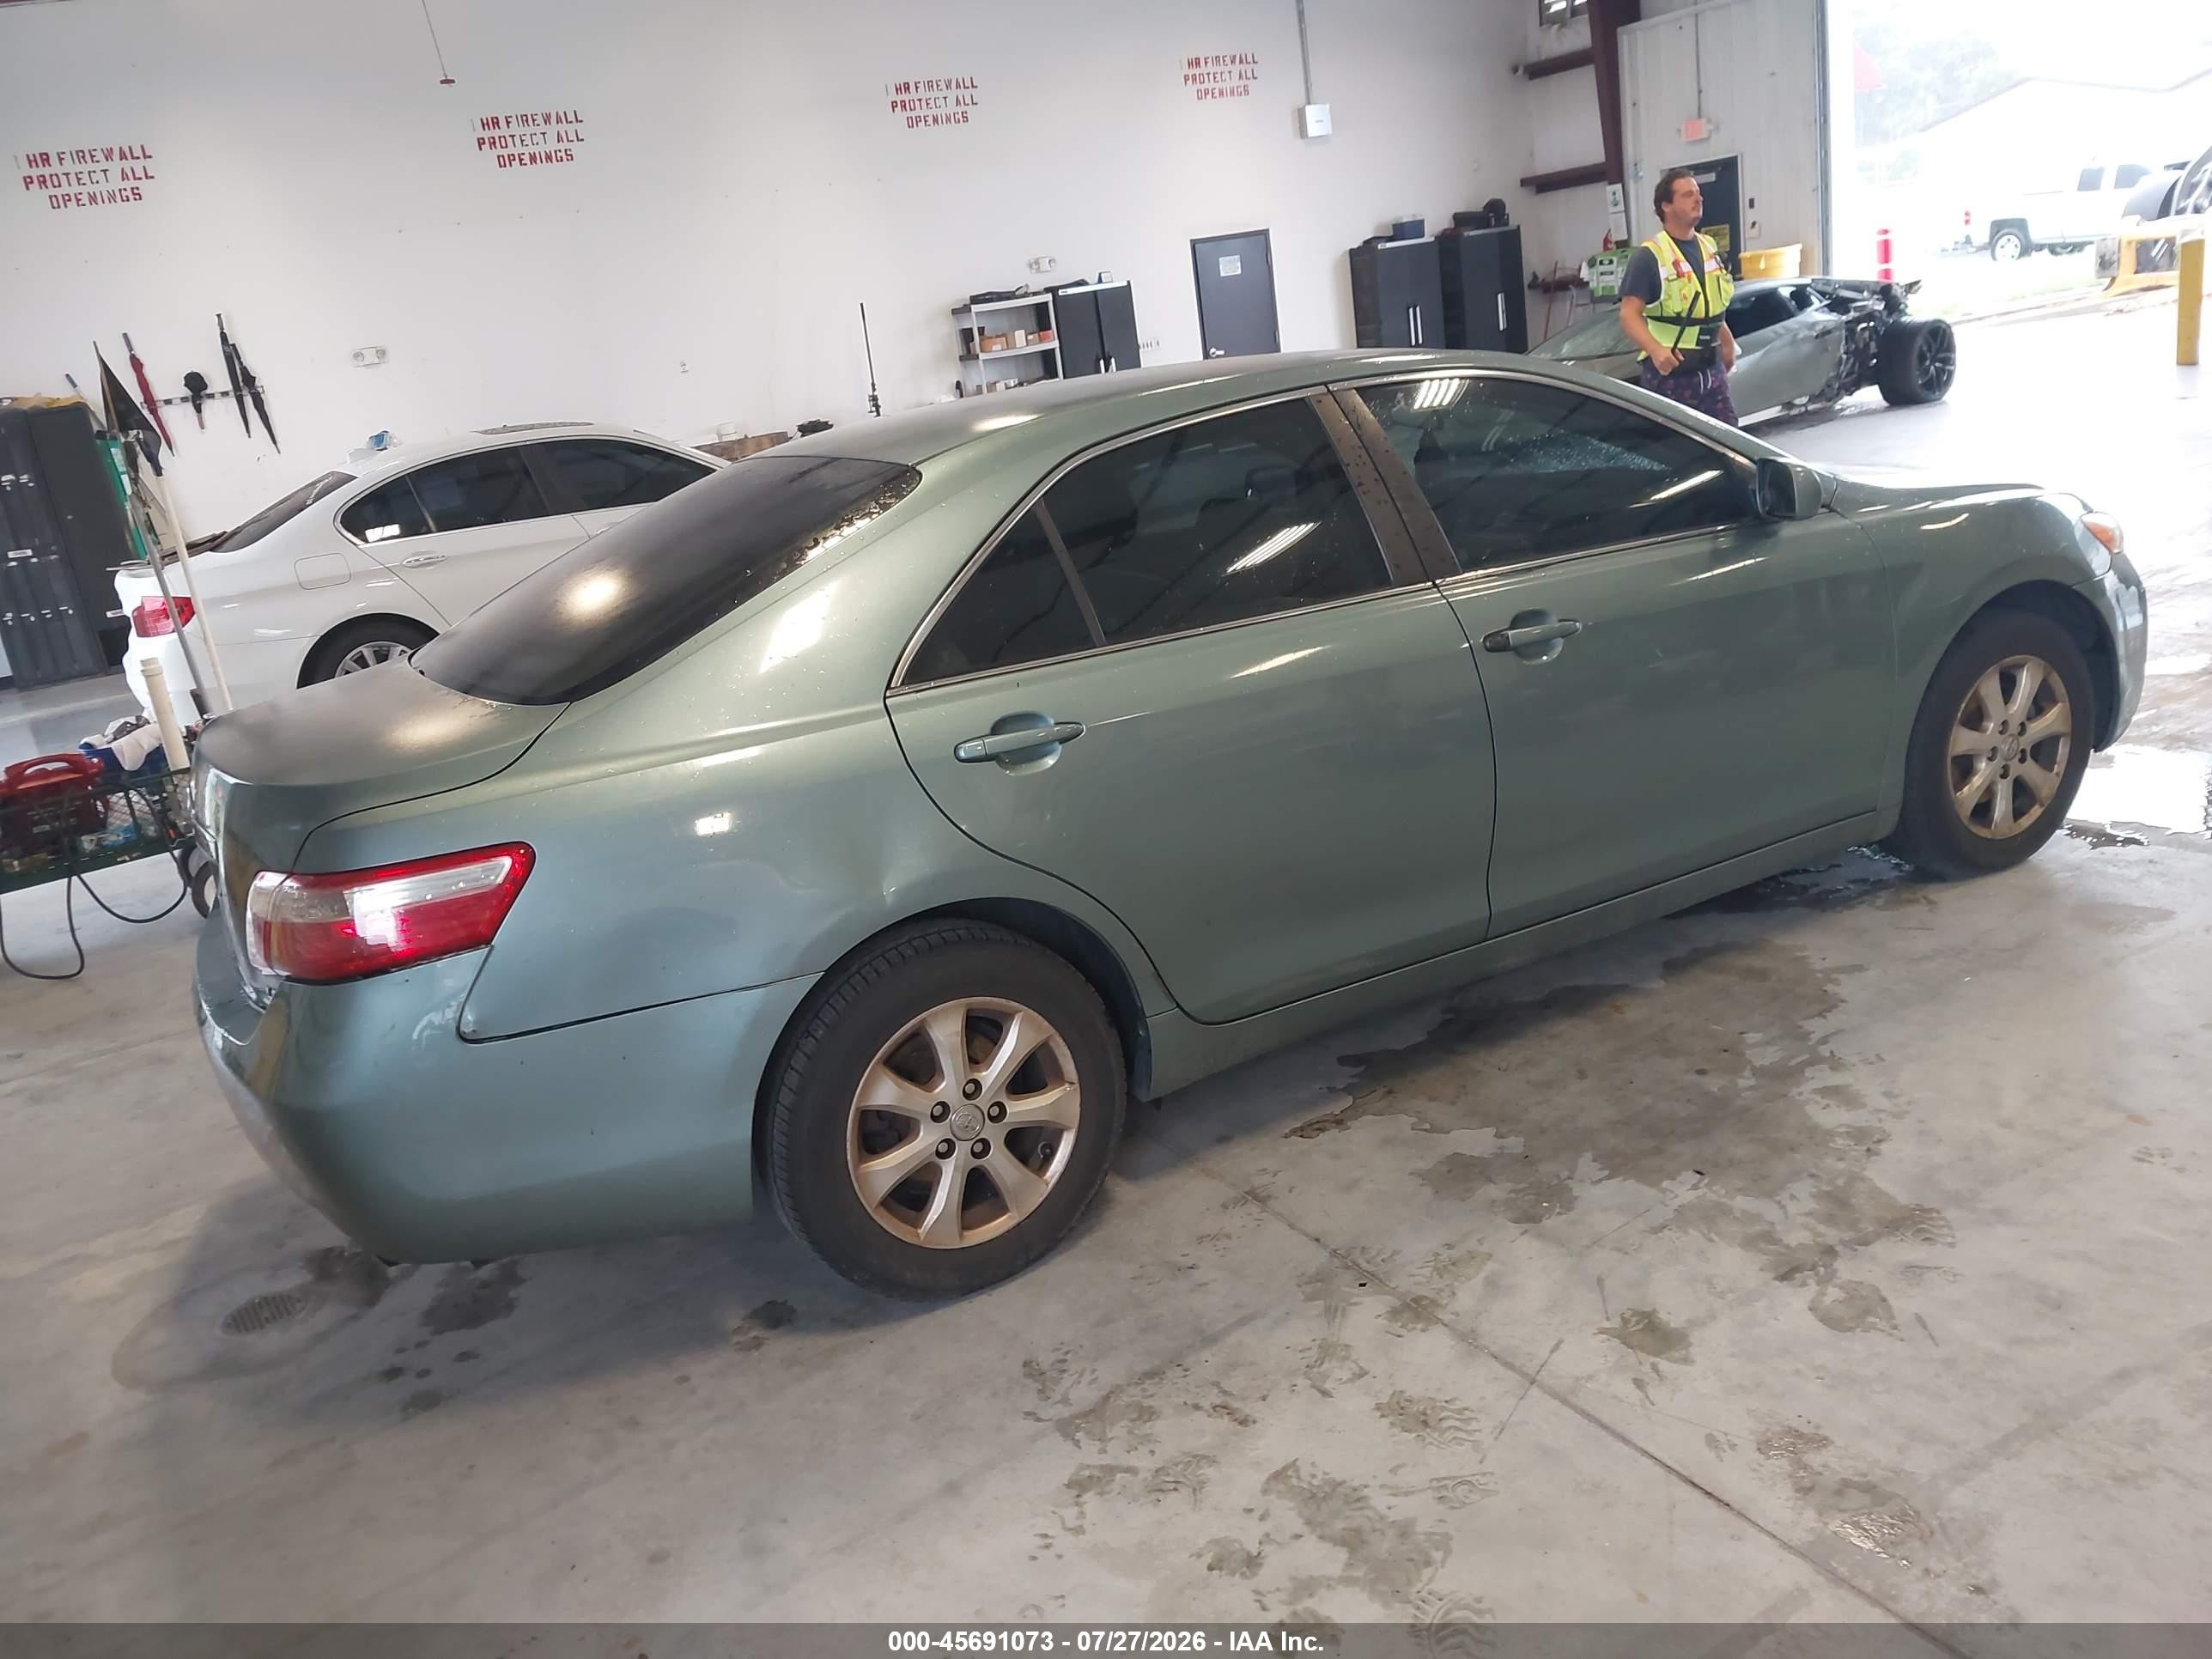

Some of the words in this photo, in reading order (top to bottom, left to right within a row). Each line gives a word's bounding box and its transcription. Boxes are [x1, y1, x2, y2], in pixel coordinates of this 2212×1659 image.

[1187, 57, 1201, 70] HR
[1204, 52, 1259, 68] FIREWALL
[894, 82, 911, 96] HR
[915, 76, 978, 94] FIREWALL
[1183, 70, 1232, 87] PROTECT
[1238, 68, 1258, 82] ALL
[1196, 84, 1249, 100] OPENINGS
[890, 96, 948, 113] PROTECT
[955, 94, 978, 107] ALL
[480, 116, 501, 131] HR
[504, 110, 583, 129] FIREWALL
[906, 111, 969, 129] OPENINGS
[477, 131, 548, 151] PROTECT
[556, 129, 585, 143] ALL
[26, 152, 52, 169] HR
[57, 144, 153, 166] FIREWALL
[496, 148, 574, 168] OPENINGS
[22, 168, 110, 191] PROTECT
[120, 165, 155, 182] ALL
[48, 186, 143, 210] OPENINGS
